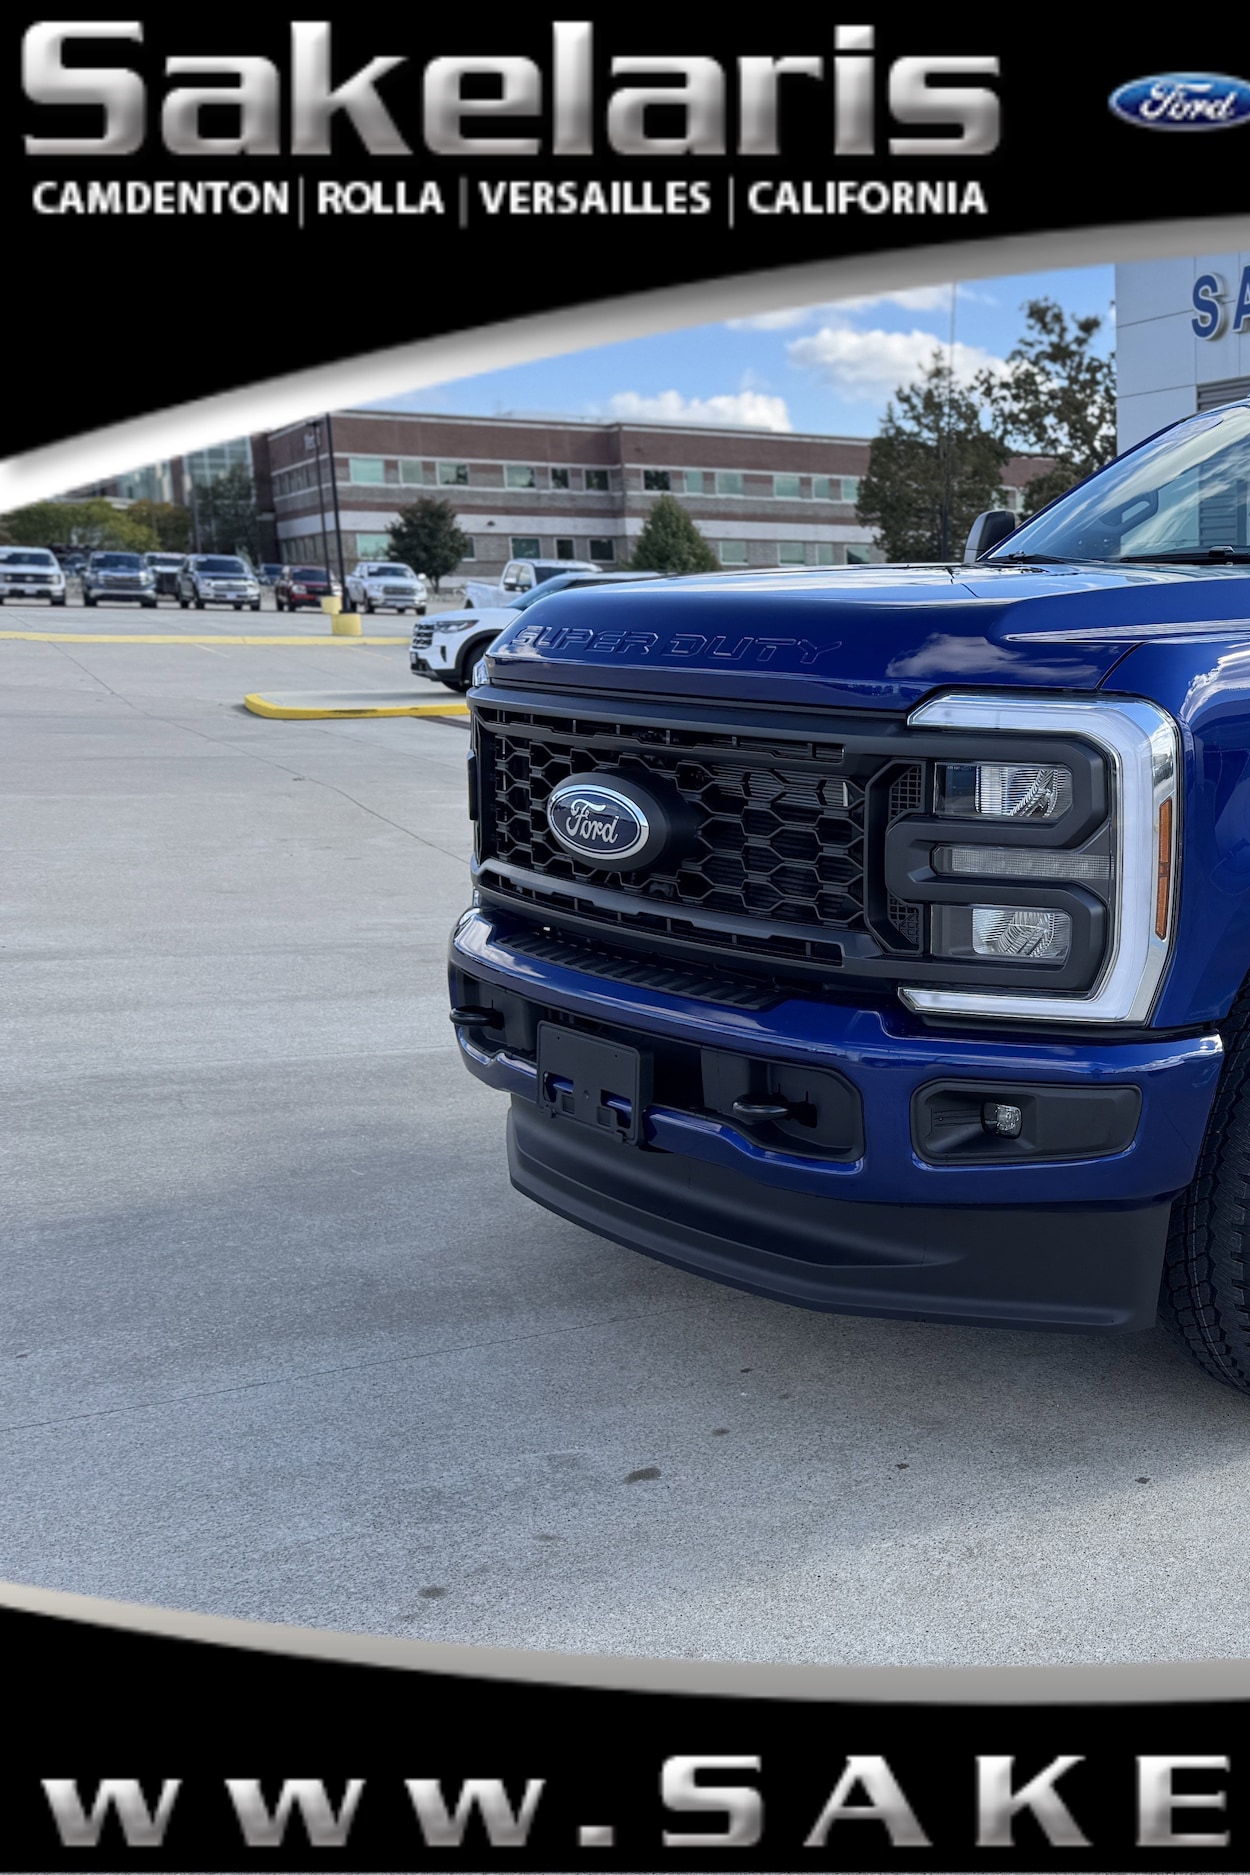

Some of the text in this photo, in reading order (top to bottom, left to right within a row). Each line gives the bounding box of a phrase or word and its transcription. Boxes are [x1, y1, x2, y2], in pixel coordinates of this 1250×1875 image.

[509, 625, 843, 664] SUPER DUTY
[565, 798, 620, 844] Ford
